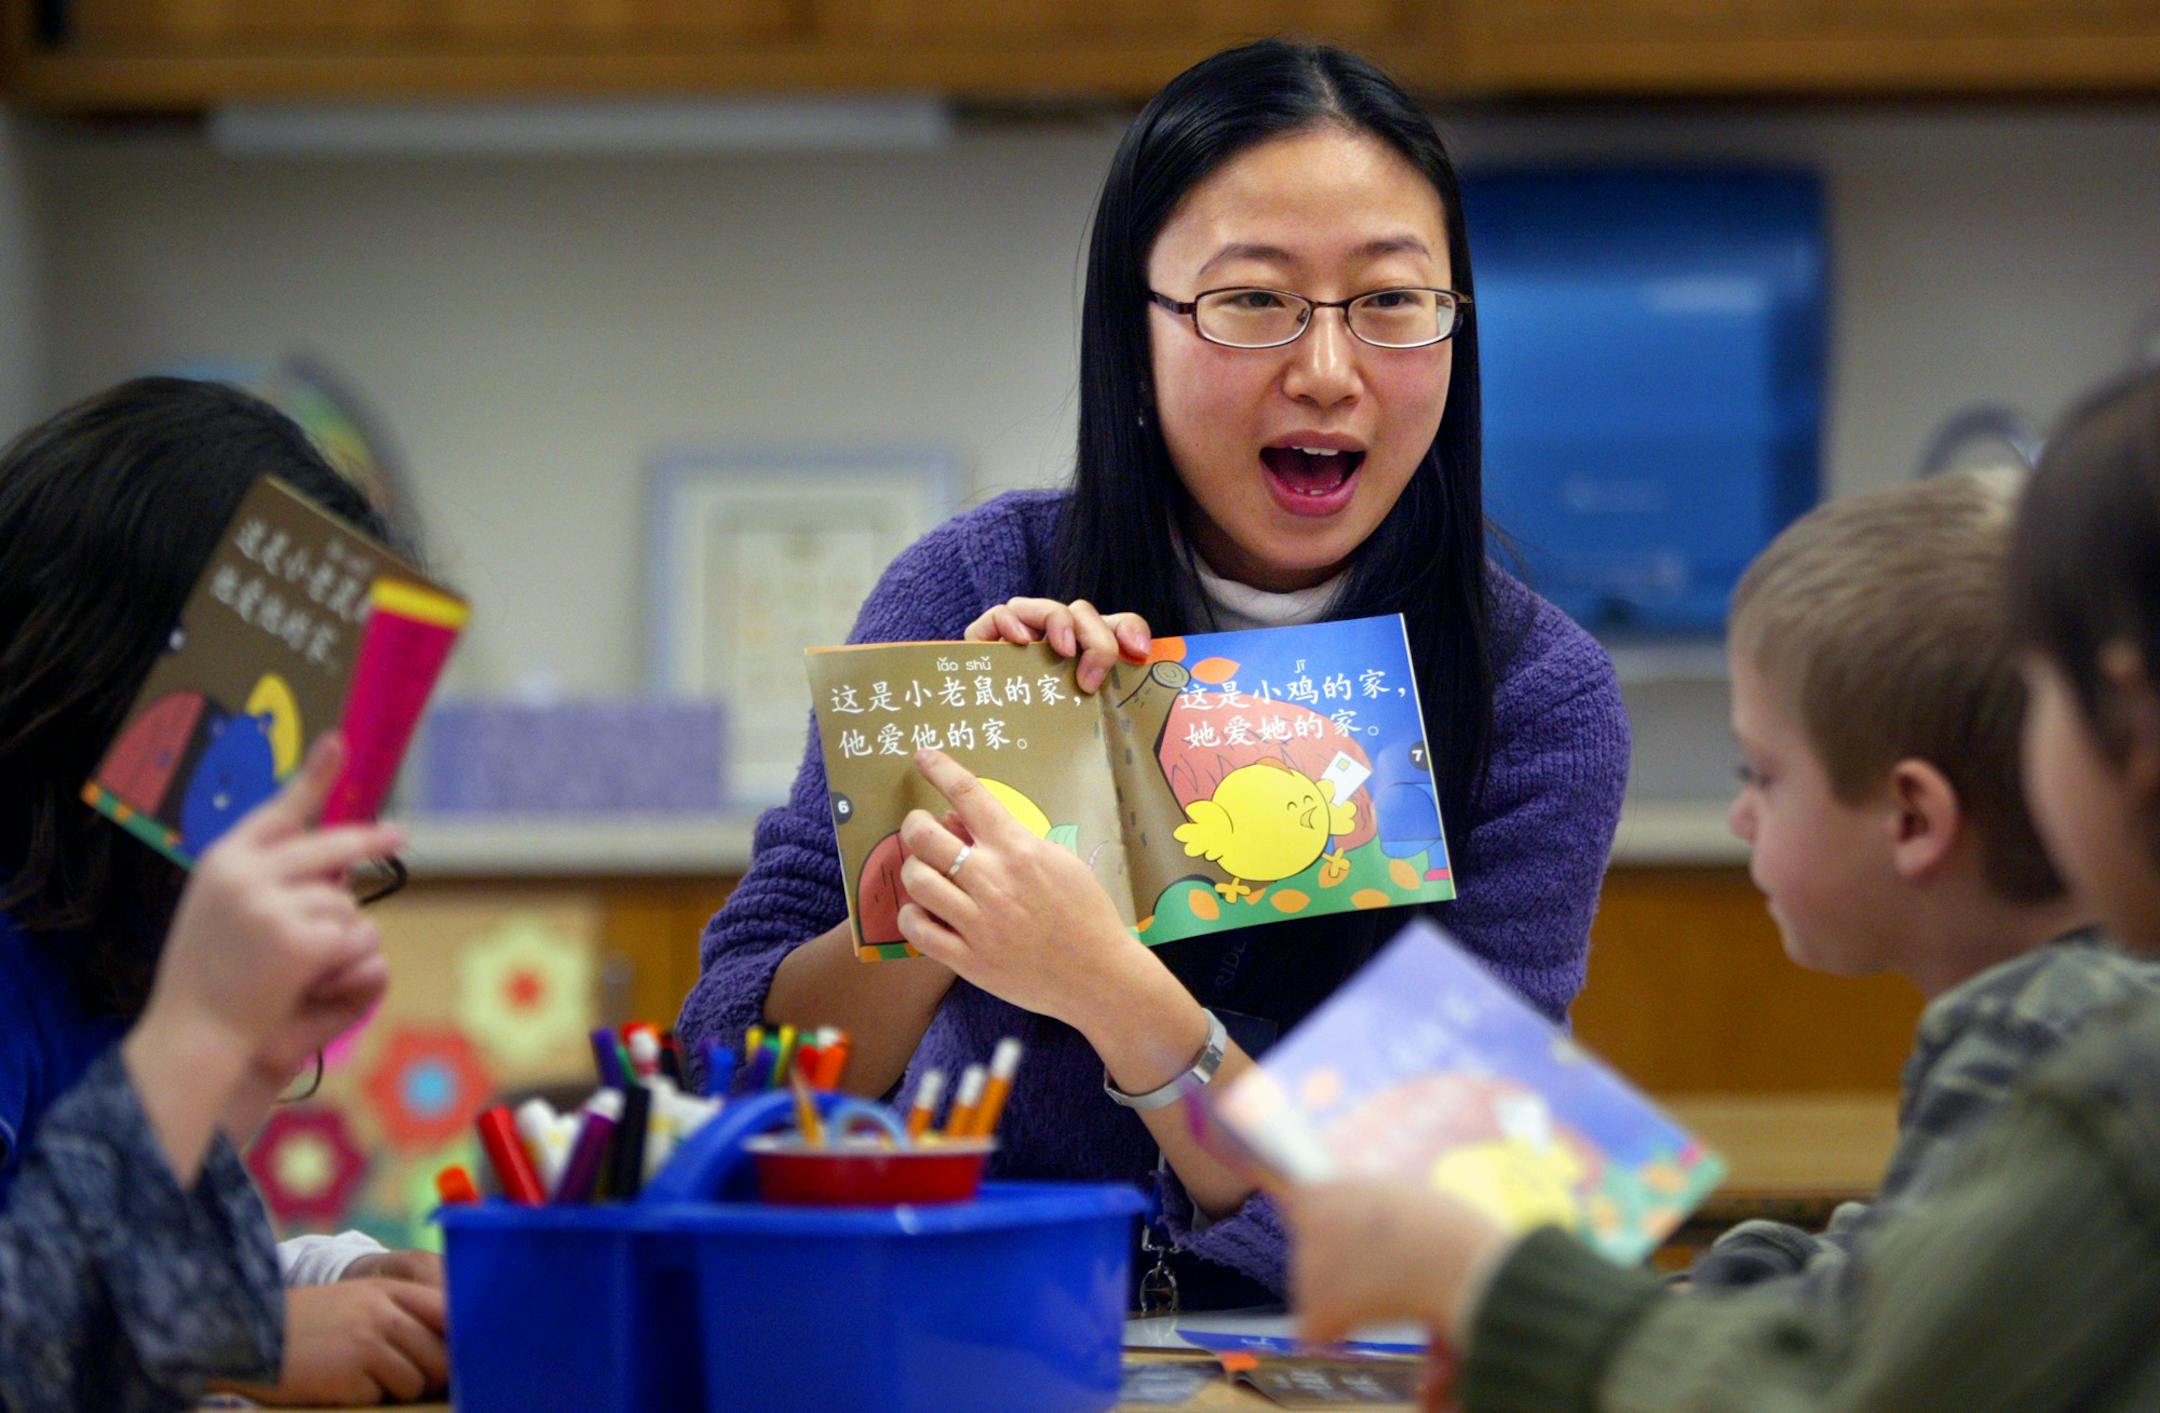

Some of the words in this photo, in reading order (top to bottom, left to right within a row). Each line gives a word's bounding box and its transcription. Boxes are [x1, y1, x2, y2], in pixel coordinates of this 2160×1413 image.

[831, 674, 1082, 713] 这是小老鼠的家，
[1179, 669, 1407, 710] 这是小鸡的家，
[839, 718, 1028, 759] 他爱他的家。
[1185, 709, 1379, 749] 她爱她的家。
[1411, 749, 1424, 762] 7
[837, 799, 850, 814] 6
